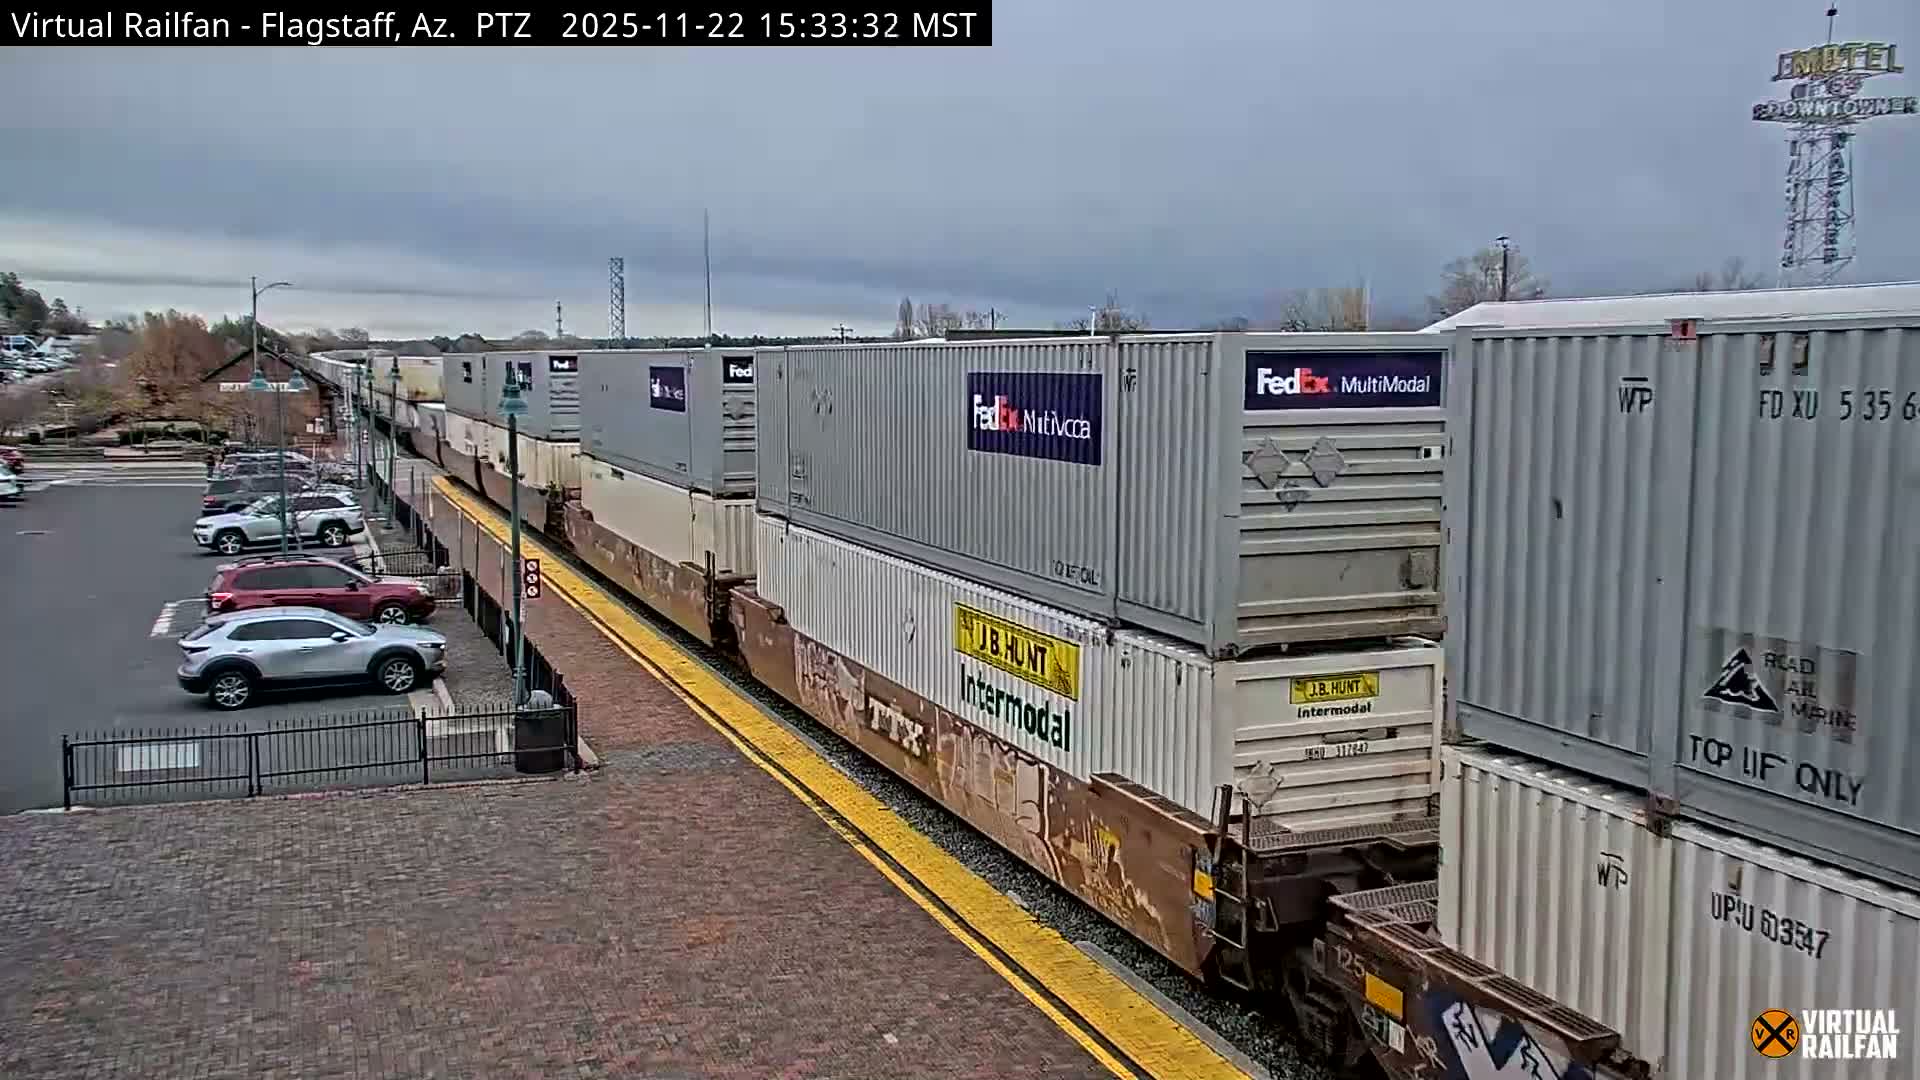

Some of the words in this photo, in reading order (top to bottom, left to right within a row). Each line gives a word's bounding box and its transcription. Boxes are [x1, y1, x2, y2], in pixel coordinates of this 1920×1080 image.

[1792, 43, 1904, 76] MOTEL
[1766, 97, 1918, 119] DOWNTOWNER
[1257, 368, 1329, 394] FedEx
[1341, 376, 1430, 393] MultiModal
[1839, 391, 1920, 420] 5356
[1005, 631, 1047, 676] HUNT
[1309, 682, 1330, 697] J.B.
[1331, 679, 1361, 695] HUNT
[960, 663, 1070, 752] Intermodal
[1297, 702, 1372, 719] Intermodal
[869, 696, 923, 757] TTX
[1689, 735, 1733, 766] TOP
[1796, 763, 1863, 806] ONLY
